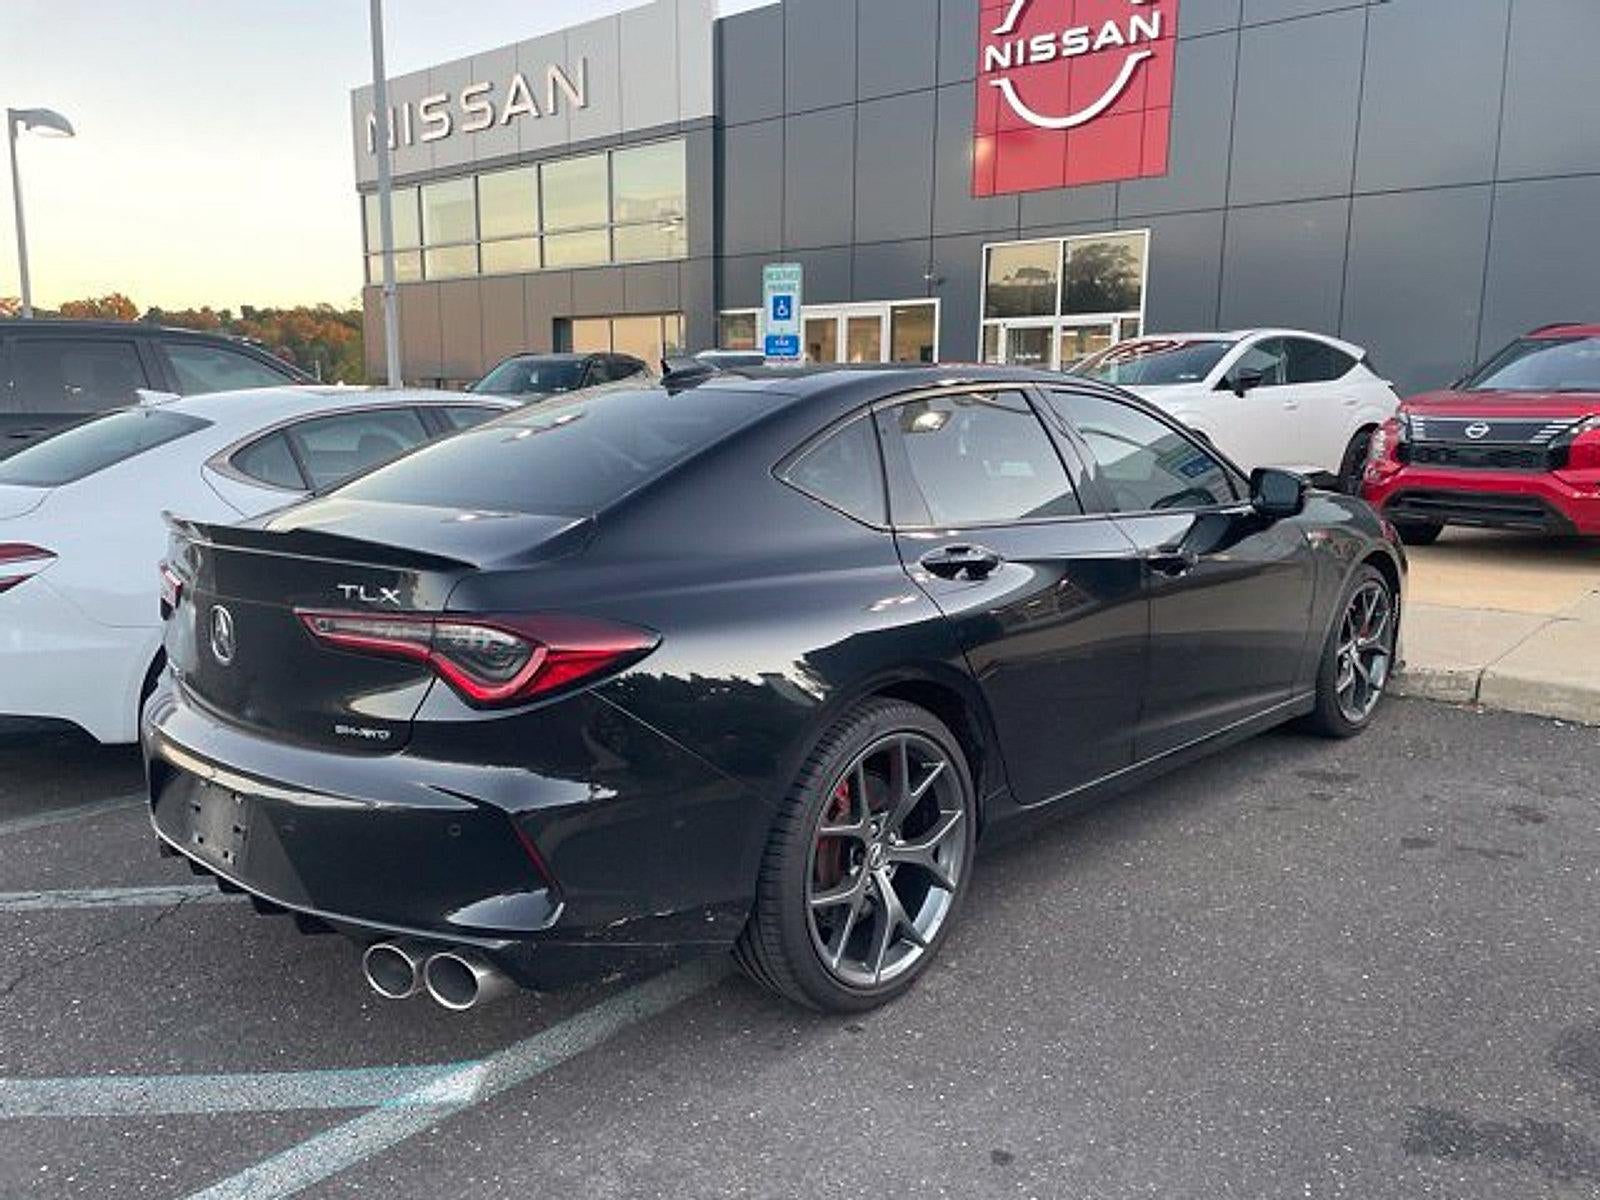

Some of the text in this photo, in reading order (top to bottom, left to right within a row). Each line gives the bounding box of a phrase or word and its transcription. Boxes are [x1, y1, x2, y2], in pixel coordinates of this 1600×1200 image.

[984, 10, 1161, 72] NISSAN
[366, 56, 588, 154] NISSAN
[337, 584, 400, 605] TLX
